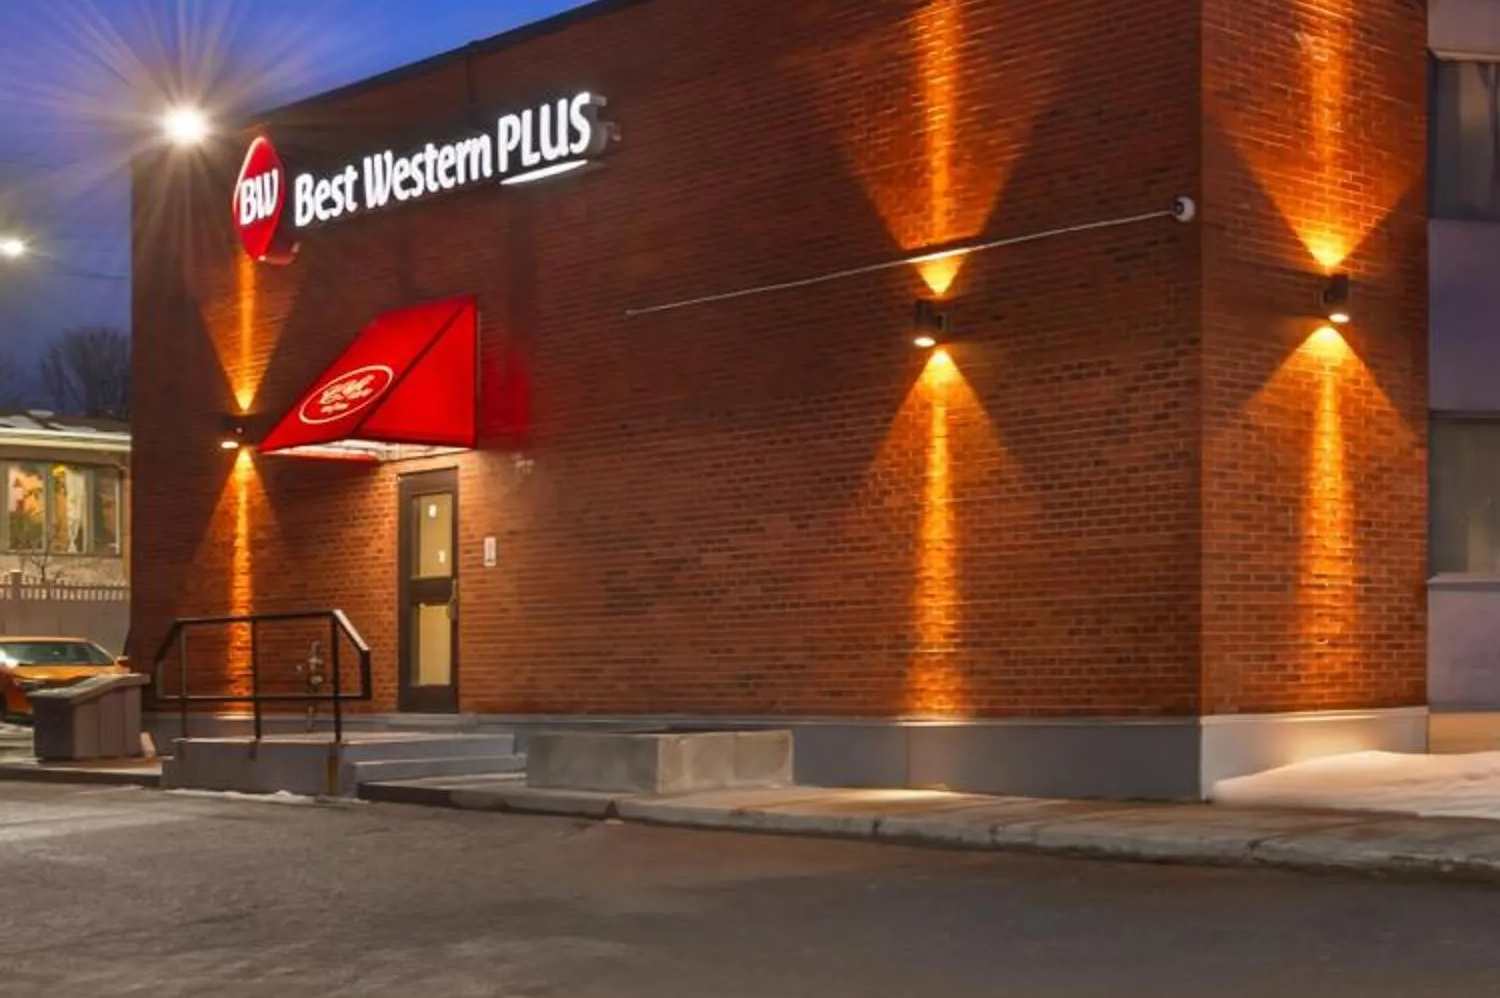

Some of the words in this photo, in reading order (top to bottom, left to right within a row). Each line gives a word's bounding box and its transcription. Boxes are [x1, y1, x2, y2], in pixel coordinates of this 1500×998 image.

[238, 169, 279, 225] BW
[294, 165, 359, 227] Best
[363, 133, 493, 208] Western
[498, 91, 592, 172] PLUS
